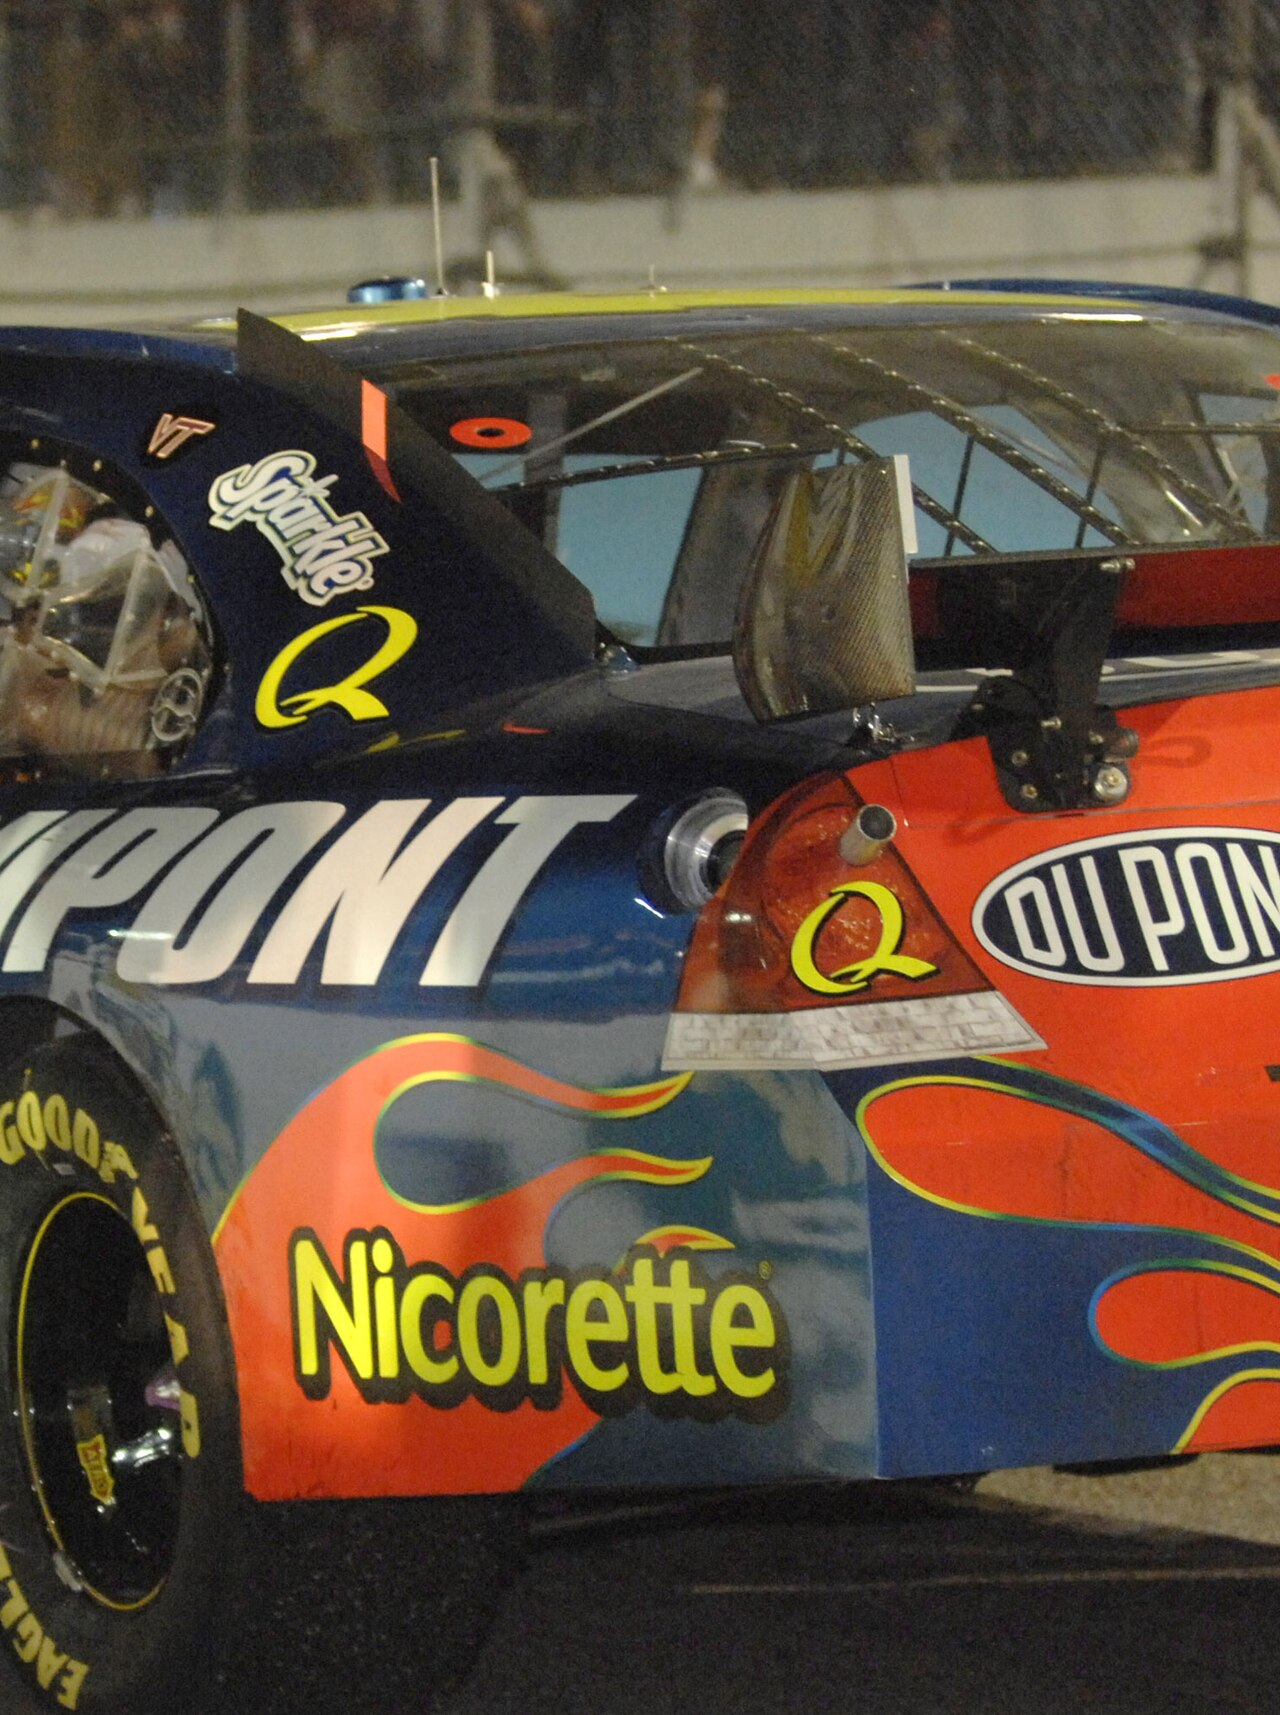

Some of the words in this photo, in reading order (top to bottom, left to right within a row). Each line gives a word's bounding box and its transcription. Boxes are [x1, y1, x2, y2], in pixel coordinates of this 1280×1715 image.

[147, 413, 216, 458] VT
[219, 455, 377, 596] Sparkle
[255, 605, 417, 728] Q
[791, 881, 938, 993] Q
[294, 1236, 776, 1398] Nicorette
